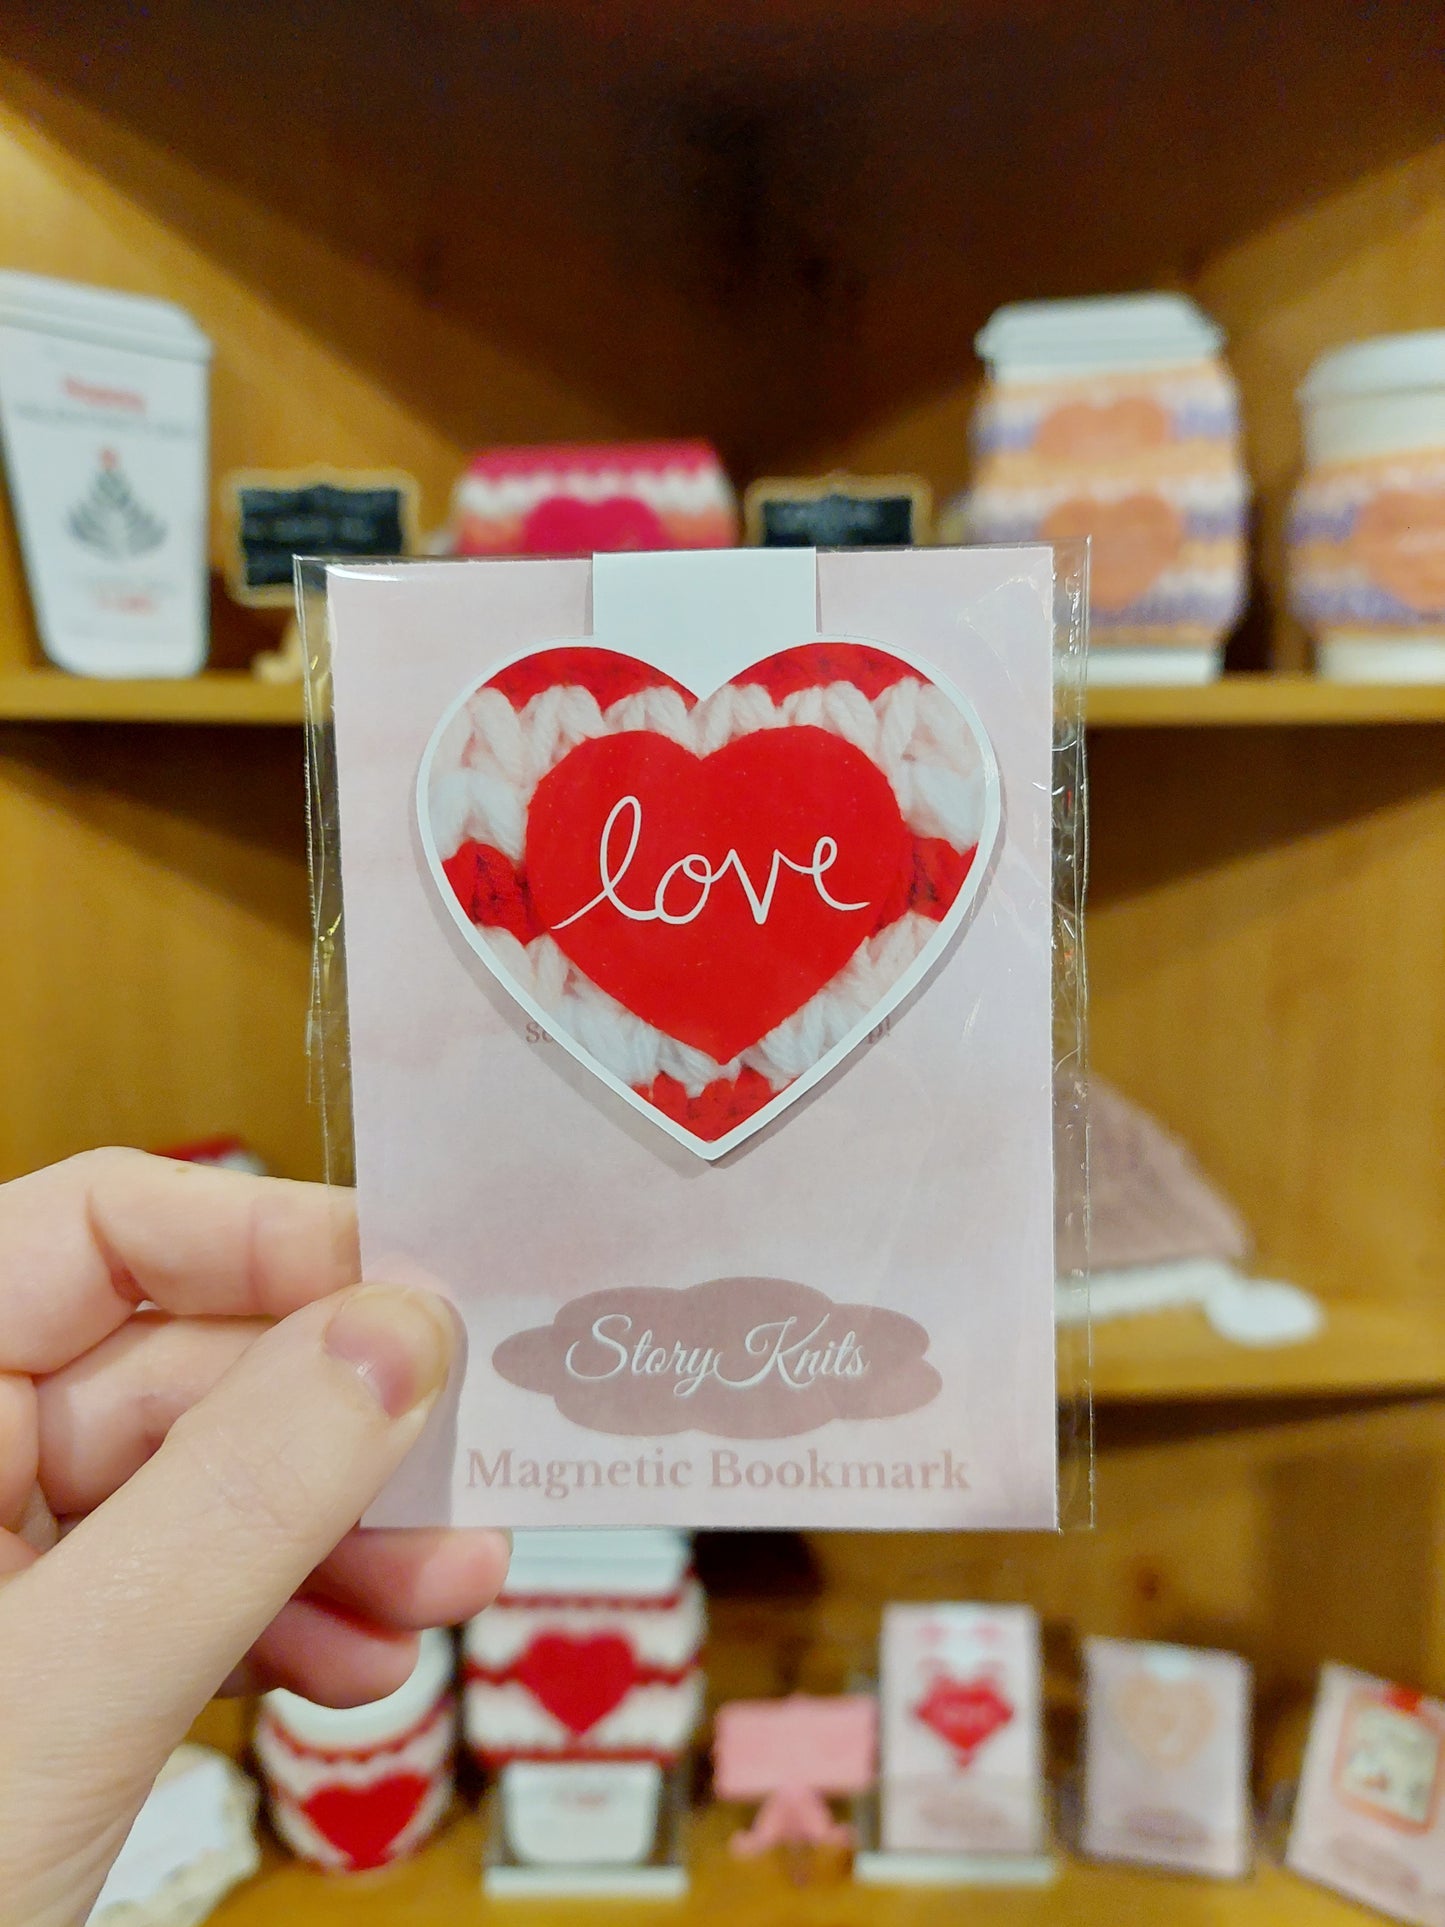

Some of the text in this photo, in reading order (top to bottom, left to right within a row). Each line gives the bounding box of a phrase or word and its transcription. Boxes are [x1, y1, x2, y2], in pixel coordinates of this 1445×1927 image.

[550, 795, 871, 931] love
[565, 1312, 870, 1398] Story Knits
[466, 1447, 972, 1499] Magnetic Bookmark
